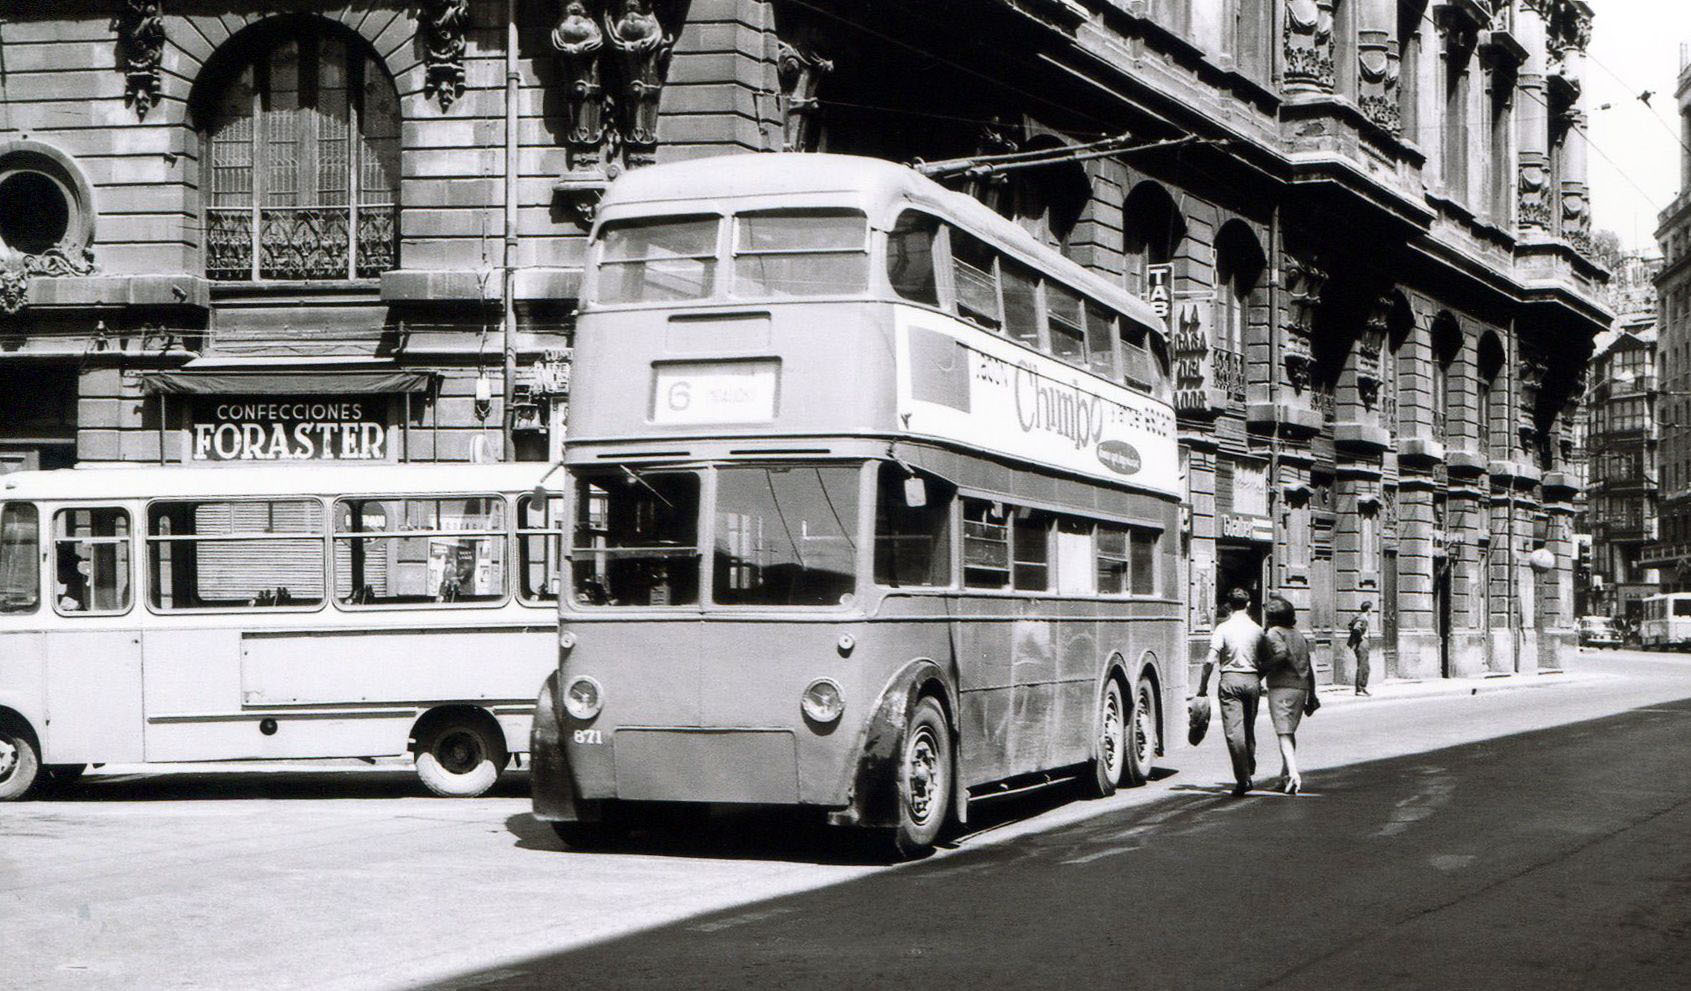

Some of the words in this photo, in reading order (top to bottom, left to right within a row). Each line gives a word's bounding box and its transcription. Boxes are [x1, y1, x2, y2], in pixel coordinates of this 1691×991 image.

[668, 381, 690, 411] 6
[1014, 359, 1102, 450] Chimbo
[217, 403, 362, 420] CONFECCIONES
[193, 421, 385, 460] FORASTER
[574, 729, 603, 745] 871
